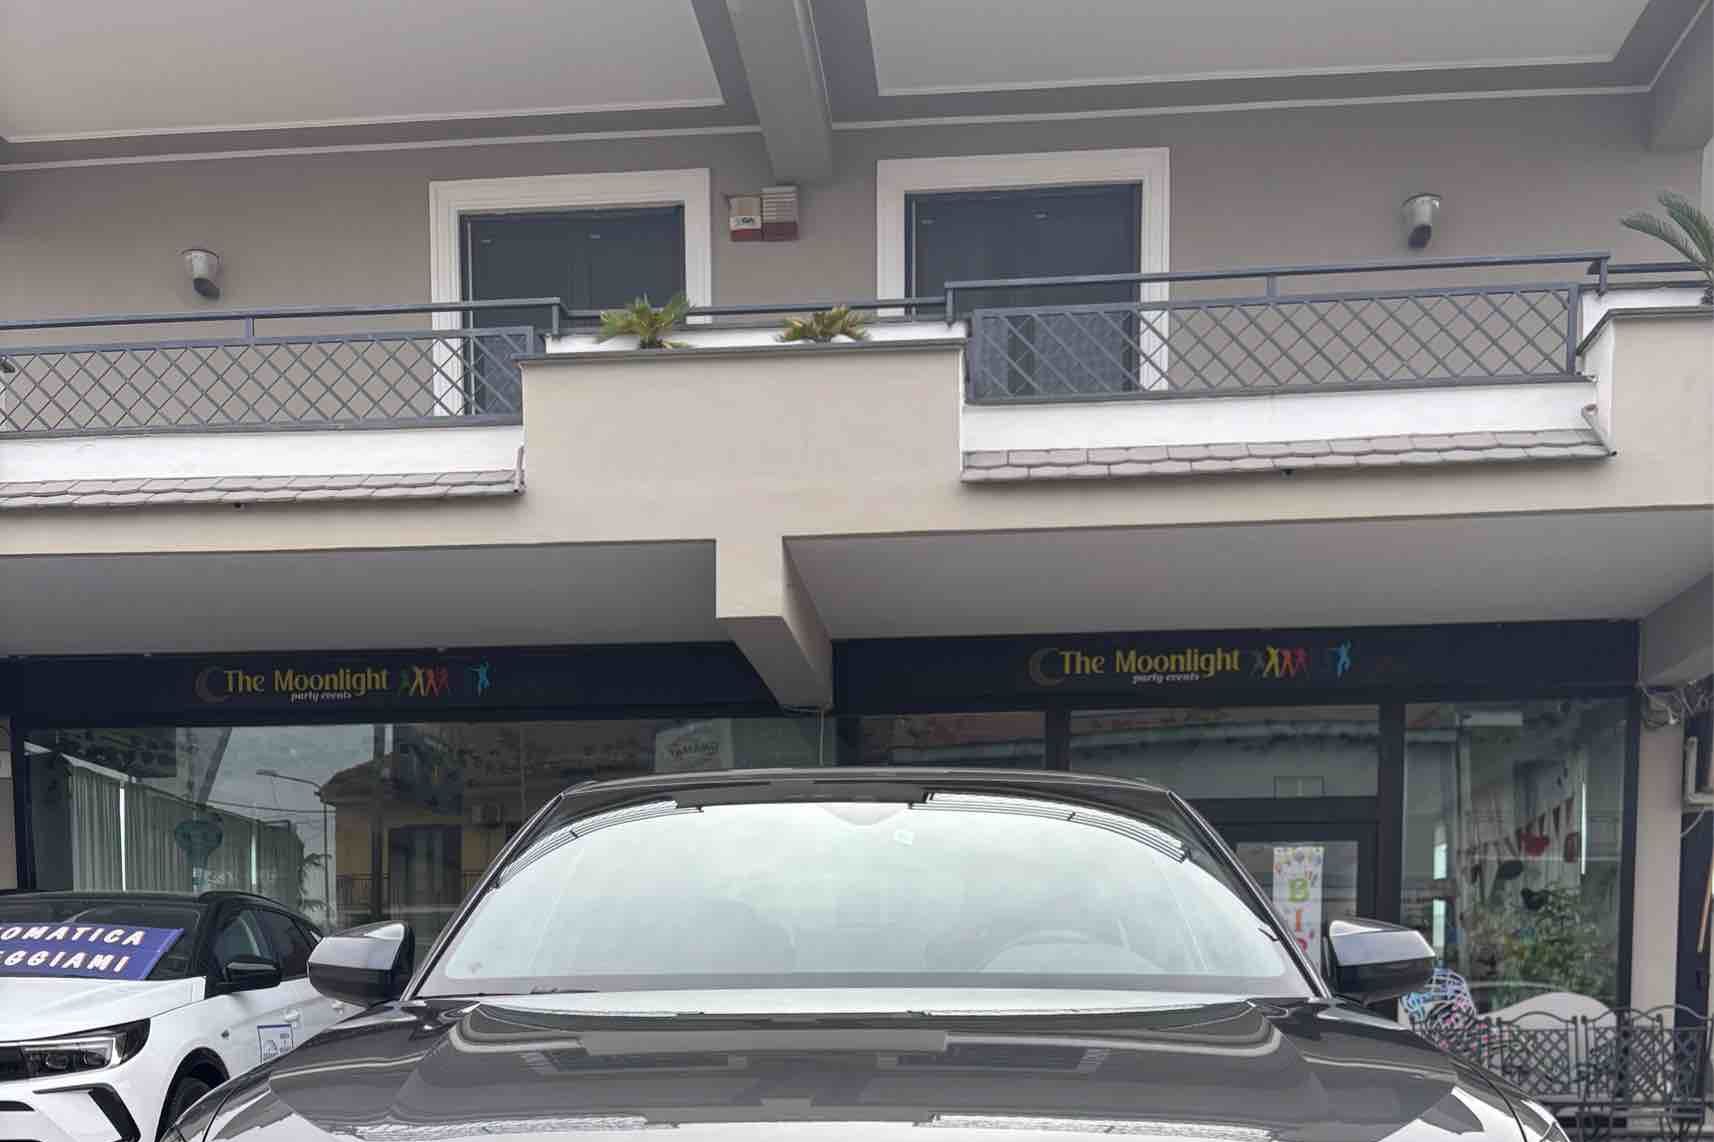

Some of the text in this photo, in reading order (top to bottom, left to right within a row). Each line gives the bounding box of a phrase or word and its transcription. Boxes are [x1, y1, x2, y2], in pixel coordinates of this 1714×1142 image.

[1059, 648, 1240, 677] The Moonlight
[223, 667, 389, 696] The Moonlight
[1132, 672, 1200, 685] party events
[290, 691, 352, 704] party events
[0, 926, 144, 945] OMATICA
[0, 950, 129, 972] GGIAMI
